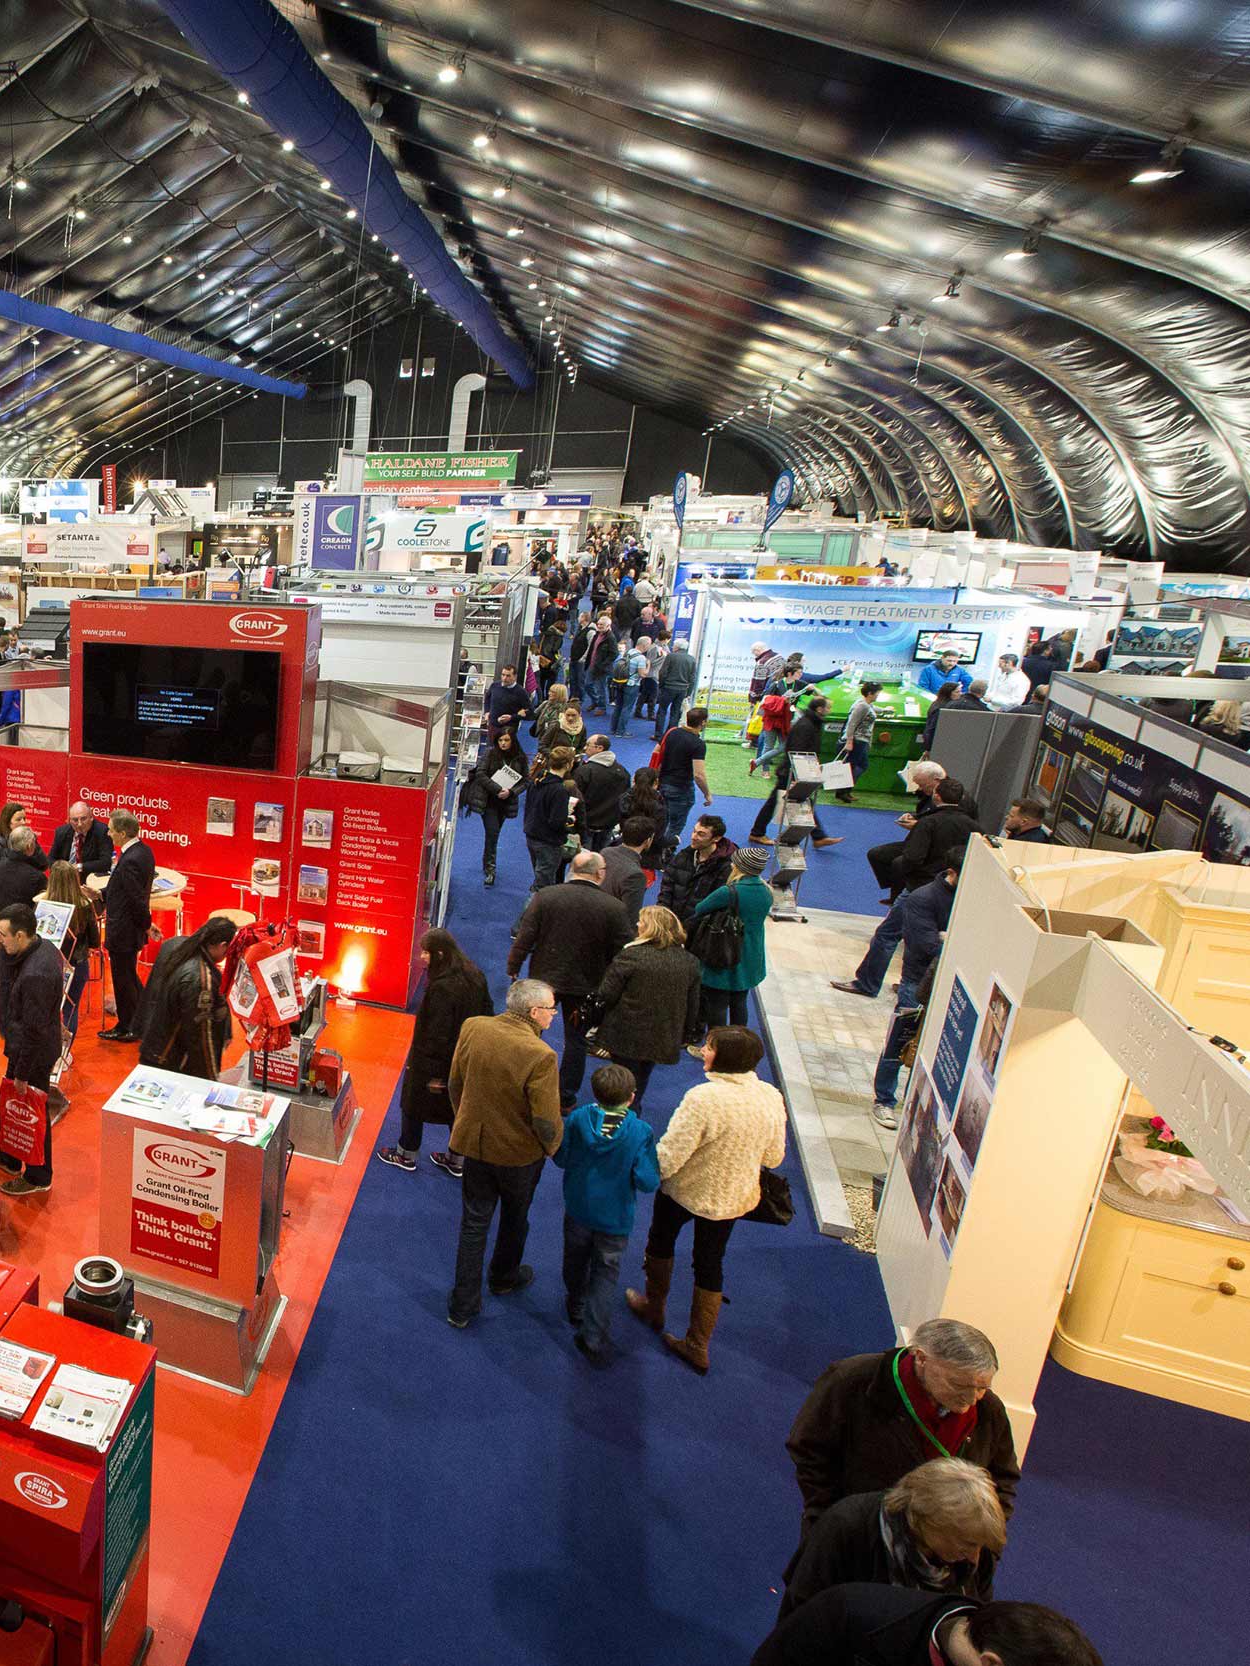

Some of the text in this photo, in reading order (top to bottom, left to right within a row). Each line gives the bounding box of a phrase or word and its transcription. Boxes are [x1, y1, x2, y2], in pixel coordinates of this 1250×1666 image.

[371, 456, 510, 470] HALDANE FISHER
[378, 469, 486, 478] YOUR SELF BUILD PARTNER
[105, 467, 114, 513] Internorm
[299, 502, 311, 567] rete.co.uk
[397, 538, 451, 547] COOLESTONE
[783, 604, 1015, 621] SEWAGE TREATMENT SYSTEMS
[236, 620, 273, 631] GRANT
[773, 625, 817, 633] TREATMENT
[818, 626, 855, 634] SYSTEMS
[81, 629, 127, 638] www.grant.eu
[79, 787, 172, 811] Green products.
[343, 806, 381, 817] Grant Vortex
[343, 814, 380, 825] Condensing
[366, 824, 388, 833] Boilers
[137, 828, 192, 847] ineering.
[341, 833, 359, 842] Grant
[341, 841, 377, 852] Condensing
[340, 848, 397, 861] Wood Pellet Boilers
[339, 860, 372, 871] Grant Solar
[337, 880, 365, 890] Cylinders
[338, 873, 386, 885] Grant Hot Water
[336, 891, 383, 904] Grant Solid Fuel
[336, 898, 369, 909] Back Boiler
[334, 922, 388, 936] www.grant.eu
[153, 1149, 198, 1169] GRANT
[146, 1177, 210, 1201] Grant Oil-fired
[136, 1183, 220, 1213] Condensing Boiler
[135, 1209, 217, 1241] Think boilers.
[137, 1220, 213, 1251] Think Grant.
[32, 1477, 51, 1489] GRANT
[26, 1480, 54, 1499] SPIRA
